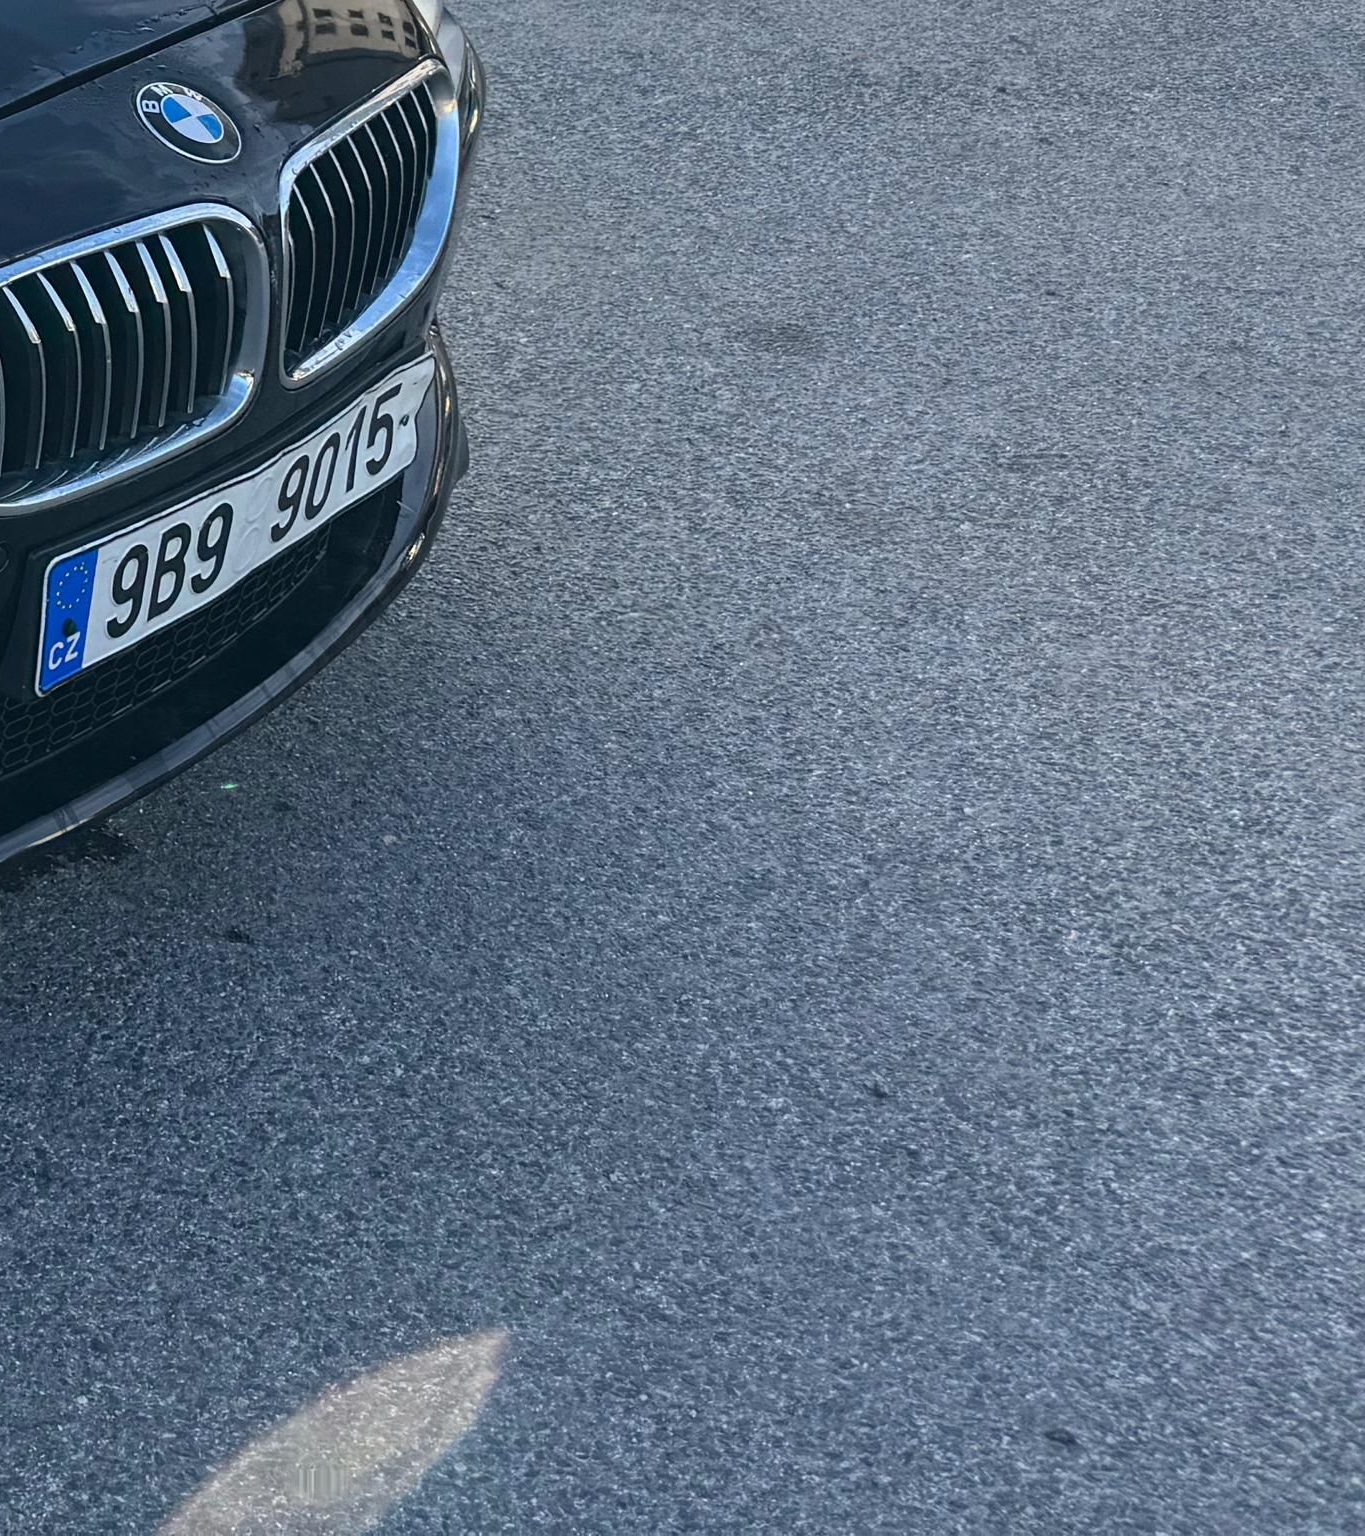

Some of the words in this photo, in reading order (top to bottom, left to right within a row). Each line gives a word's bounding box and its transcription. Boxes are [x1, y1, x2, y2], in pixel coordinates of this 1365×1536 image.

[141, 83, 204, 115] BMW
[106, 502, 235, 639] 9B9
[270, 382, 402, 543] 9015
[48, 635, 81, 670] CZ
